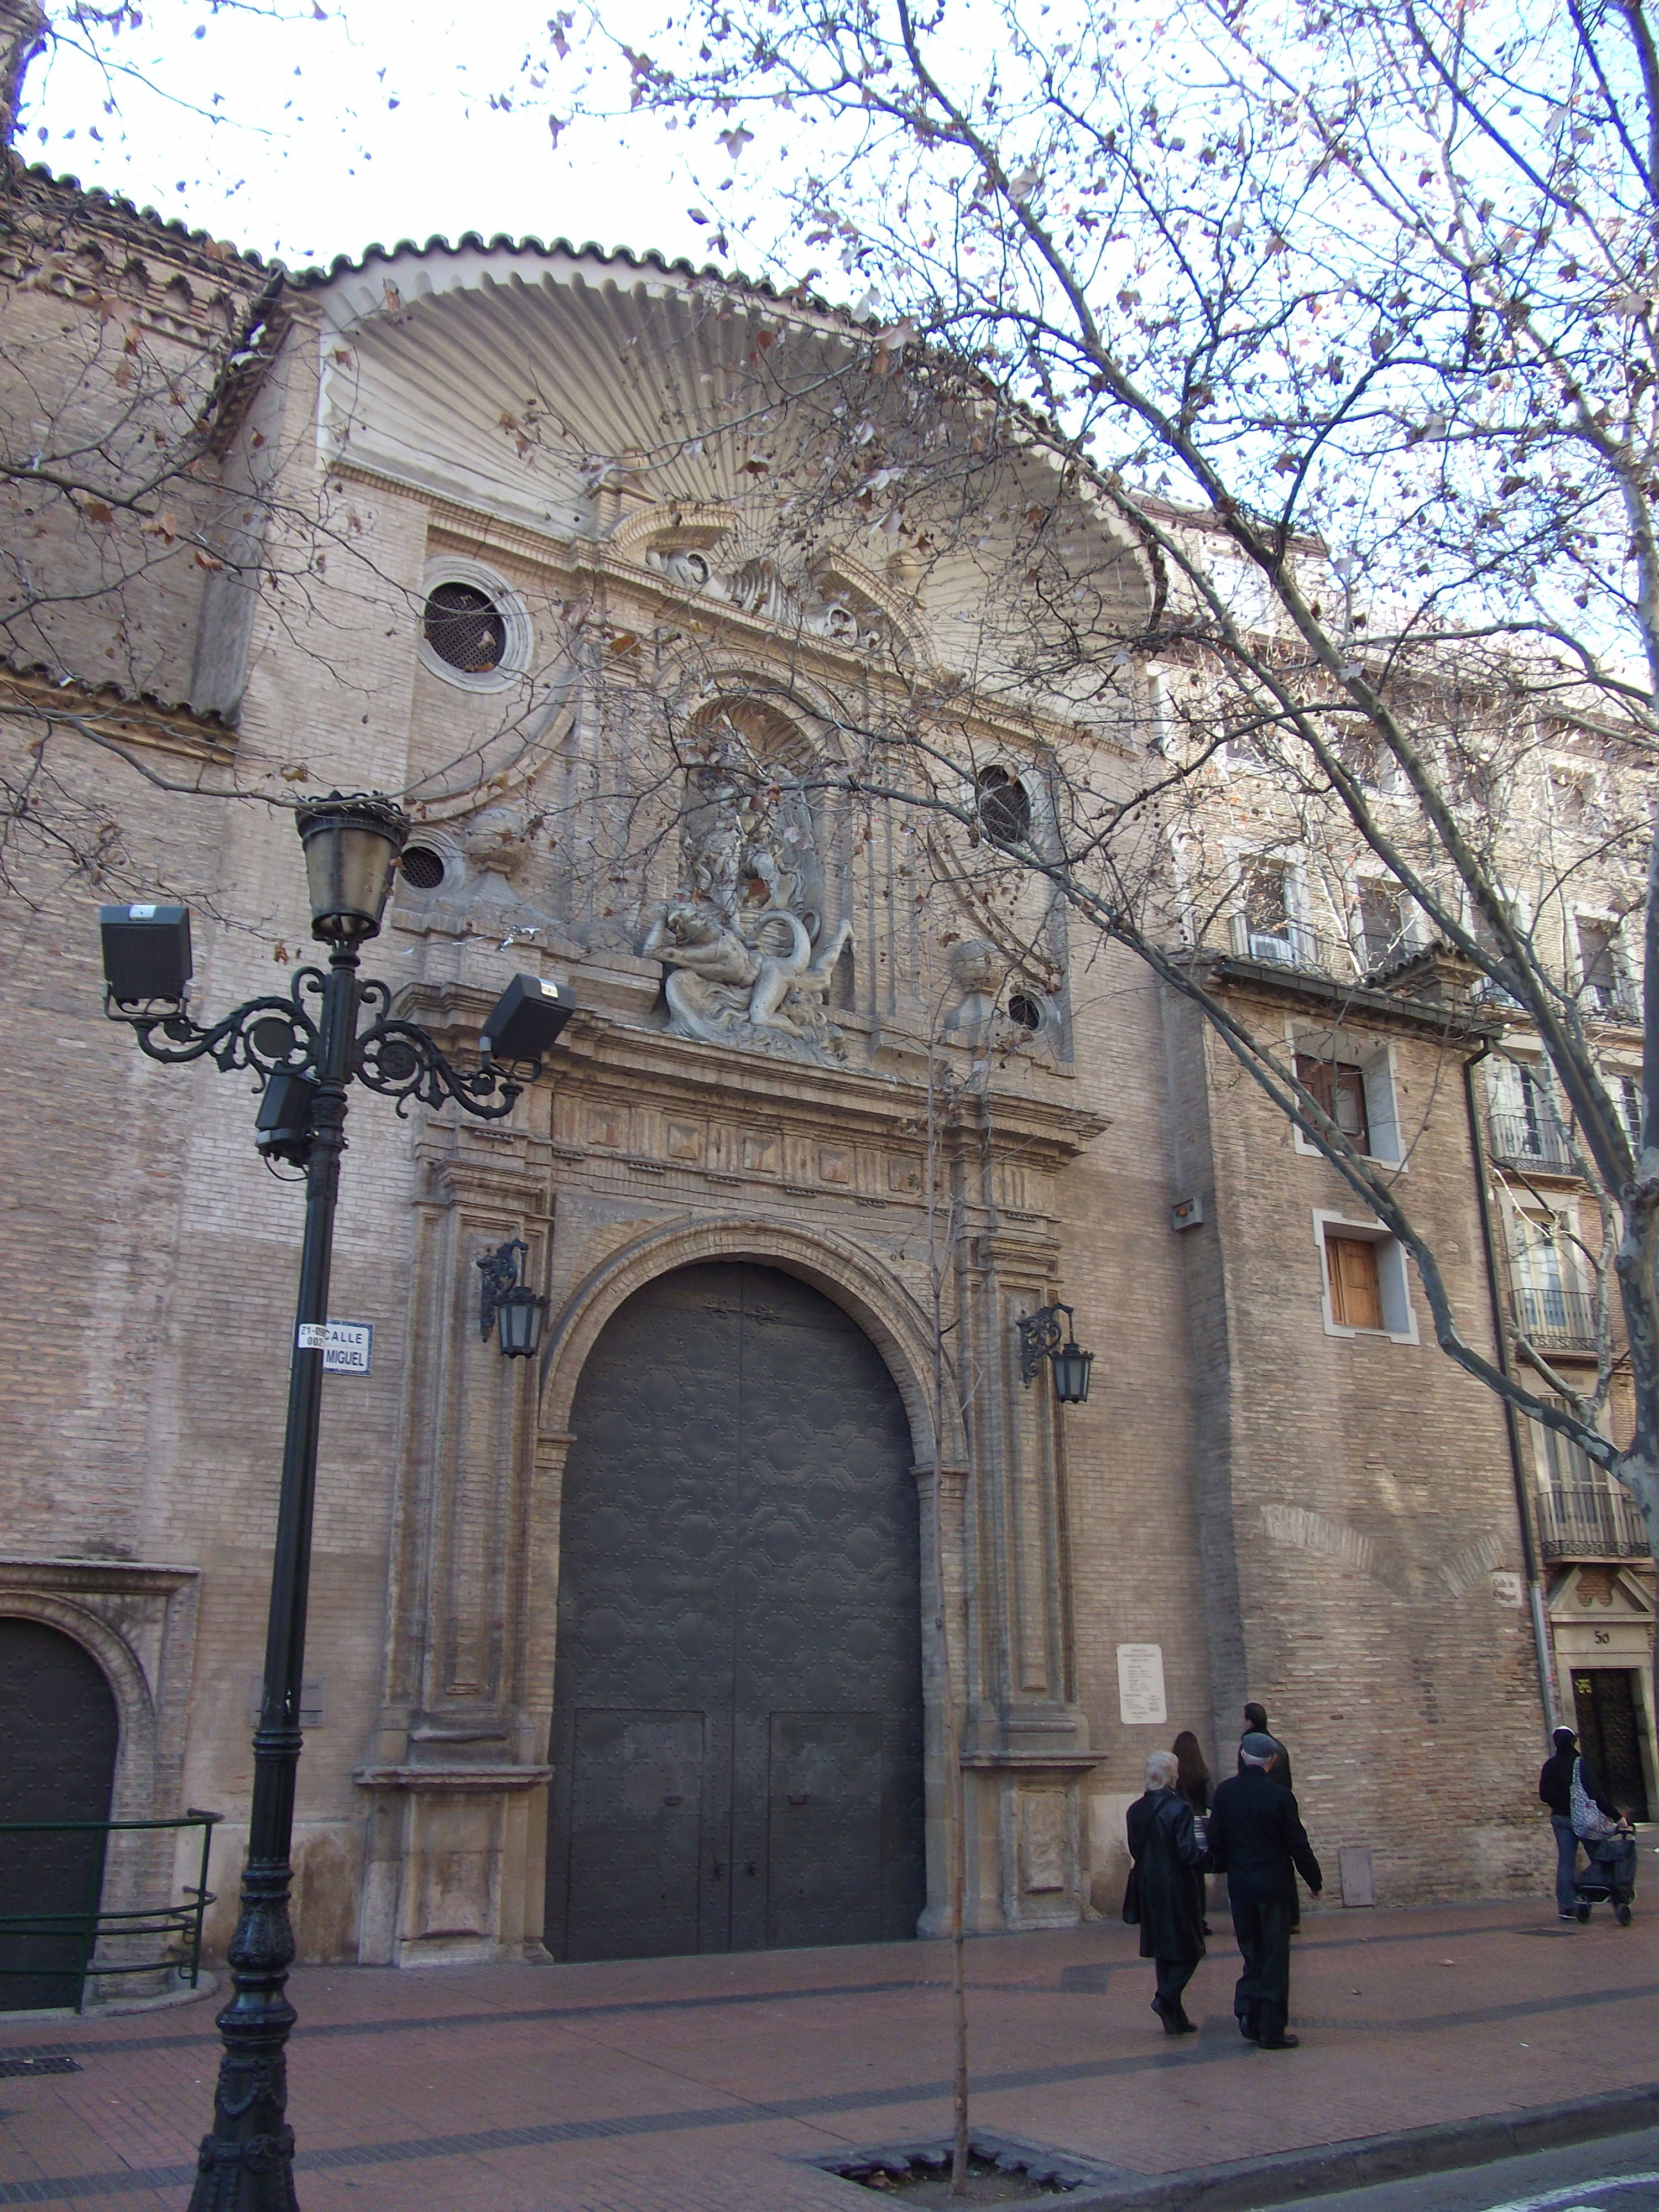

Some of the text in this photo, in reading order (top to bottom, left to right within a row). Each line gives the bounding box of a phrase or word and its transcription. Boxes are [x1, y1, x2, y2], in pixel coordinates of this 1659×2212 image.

[307, 1337, 323, 1347] 002
[324, 1329, 363, 1344] CALLE
[326, 1349, 364, 1366] MIGUEL
[1594, 1631, 1610, 1644] 50
